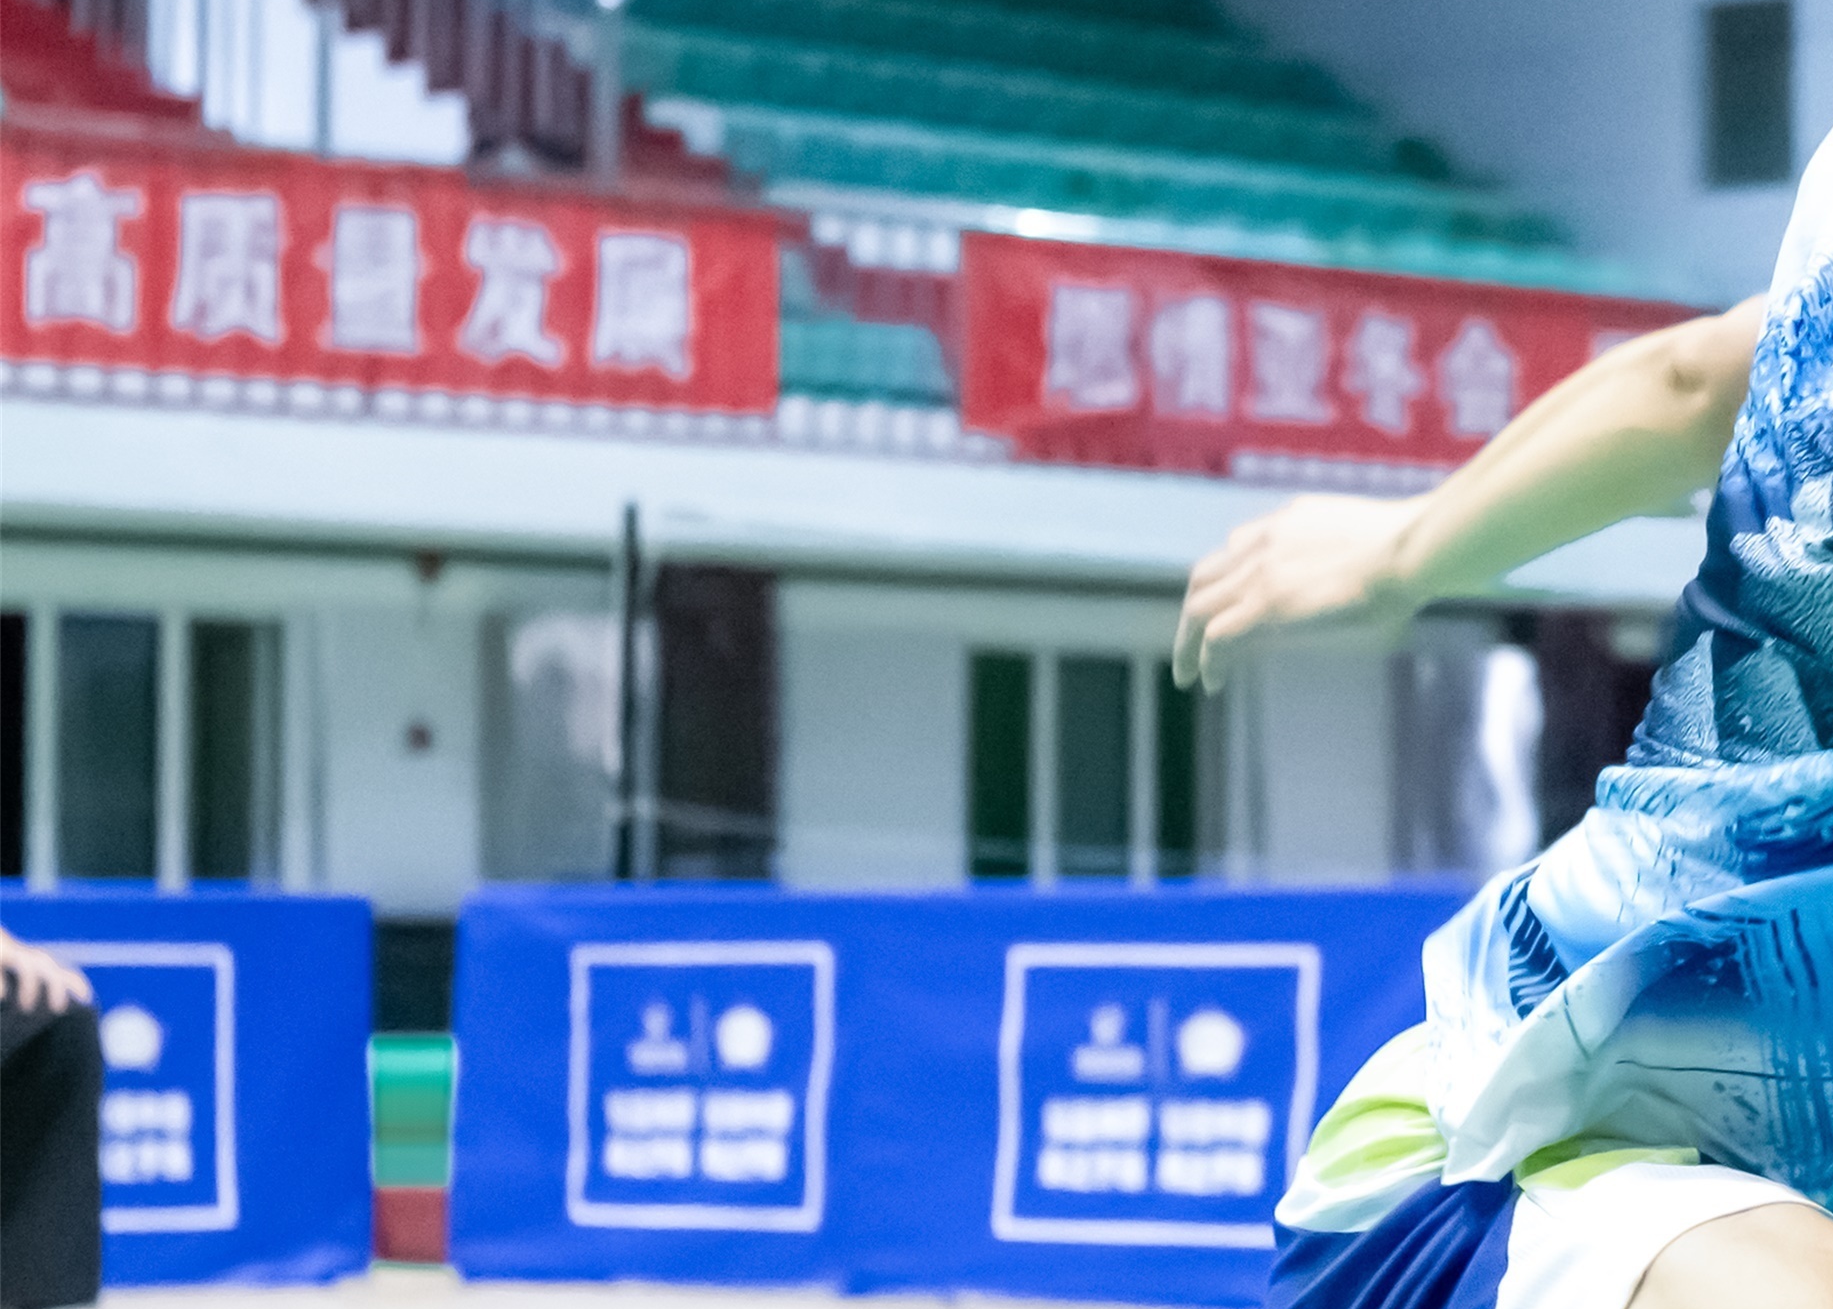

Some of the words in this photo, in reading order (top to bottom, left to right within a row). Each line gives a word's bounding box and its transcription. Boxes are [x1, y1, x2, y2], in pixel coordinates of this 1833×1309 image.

[22, 173, 692, 379] 高质量发展
